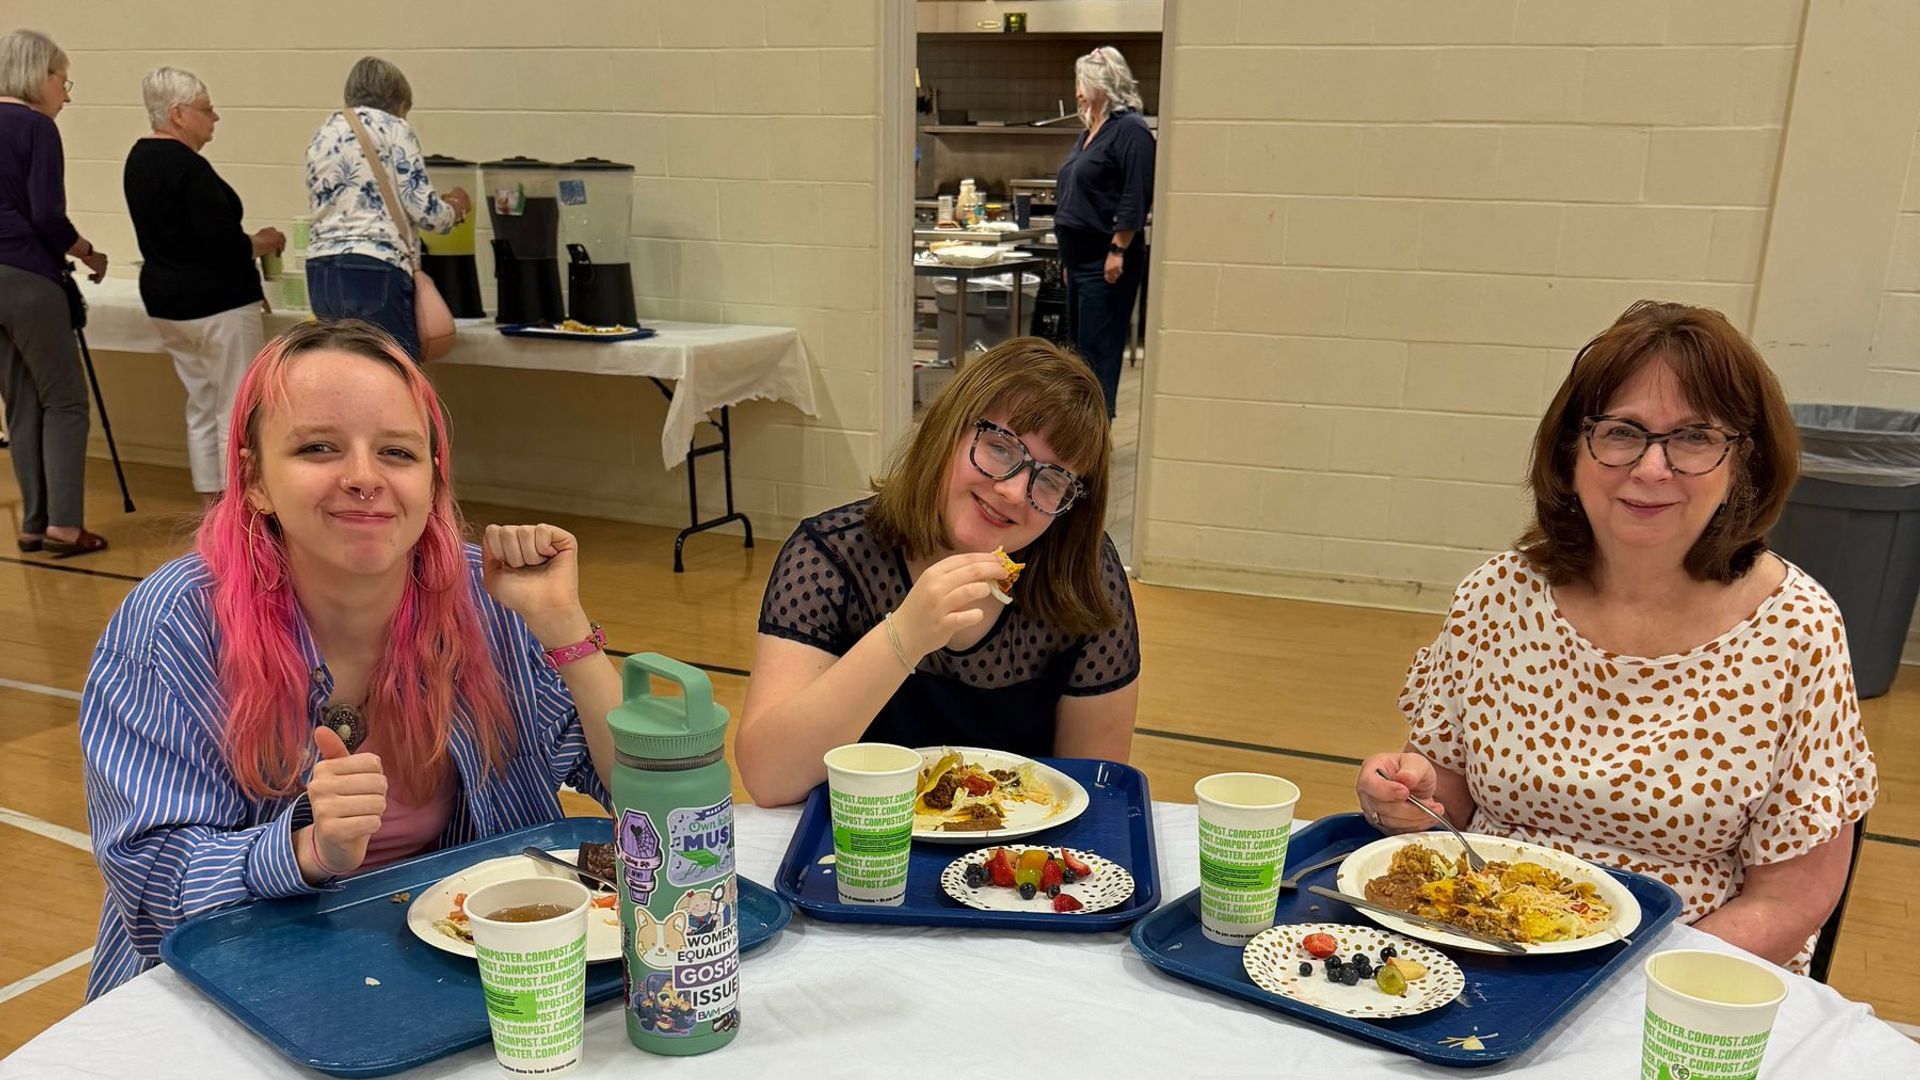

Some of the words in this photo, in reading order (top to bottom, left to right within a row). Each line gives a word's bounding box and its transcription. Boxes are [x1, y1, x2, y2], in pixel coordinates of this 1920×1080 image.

[683, 824, 731, 852] MUS
[689, 821, 715, 833] Own
[678, 938, 731, 963] EQUALITY
[693, 976, 737, 1007] ISSUE
